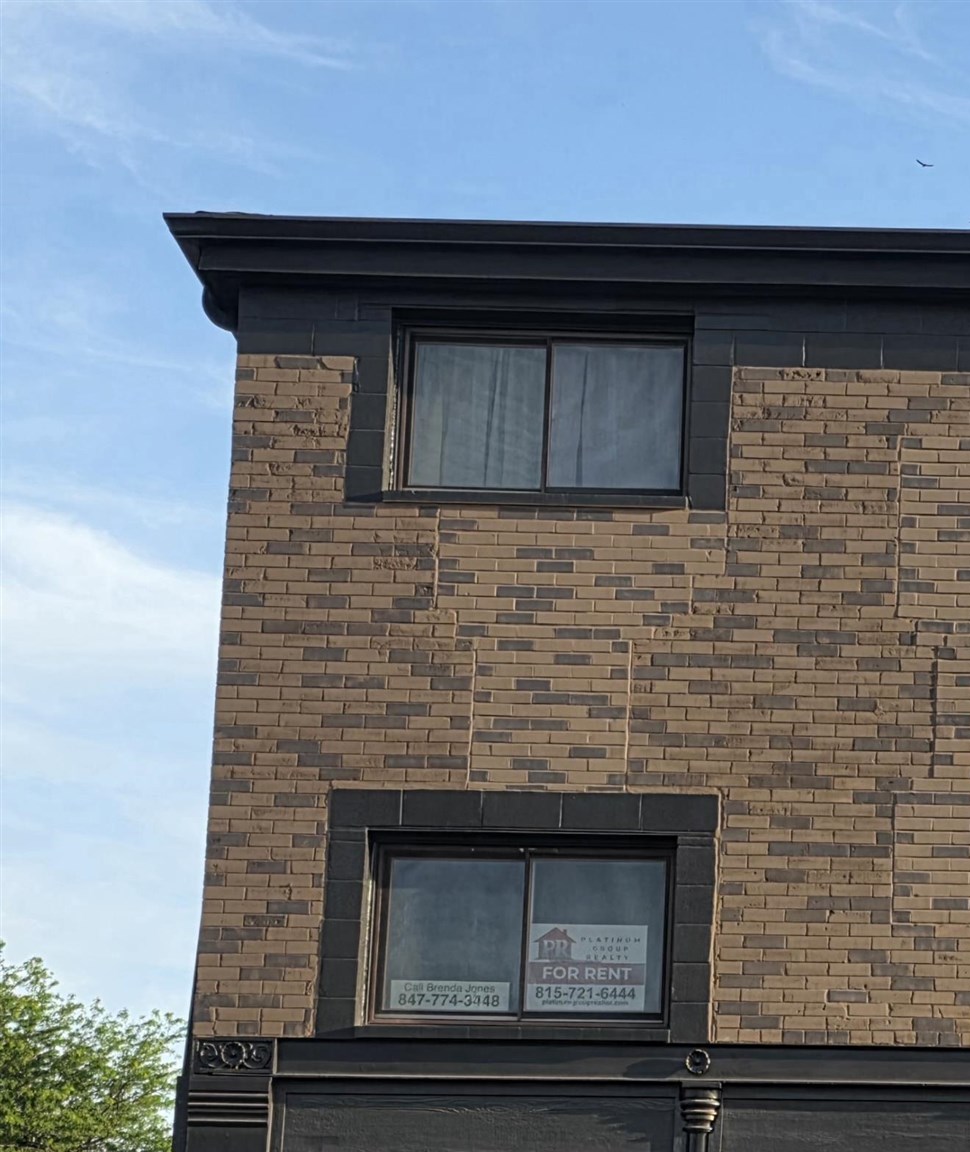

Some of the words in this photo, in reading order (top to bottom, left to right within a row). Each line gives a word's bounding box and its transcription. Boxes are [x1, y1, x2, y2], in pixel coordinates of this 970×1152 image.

[542, 966, 579, 980] FOR
[584, 967, 632, 981] RENT
[404, 982, 424, 992] Call
[426, 983, 463, 993] Brenda
[465, 985, 496, 994] Jones
[535, 986, 636, 1000] 815-721-6444
[398, 993, 500, 1007] 847-774-3448
